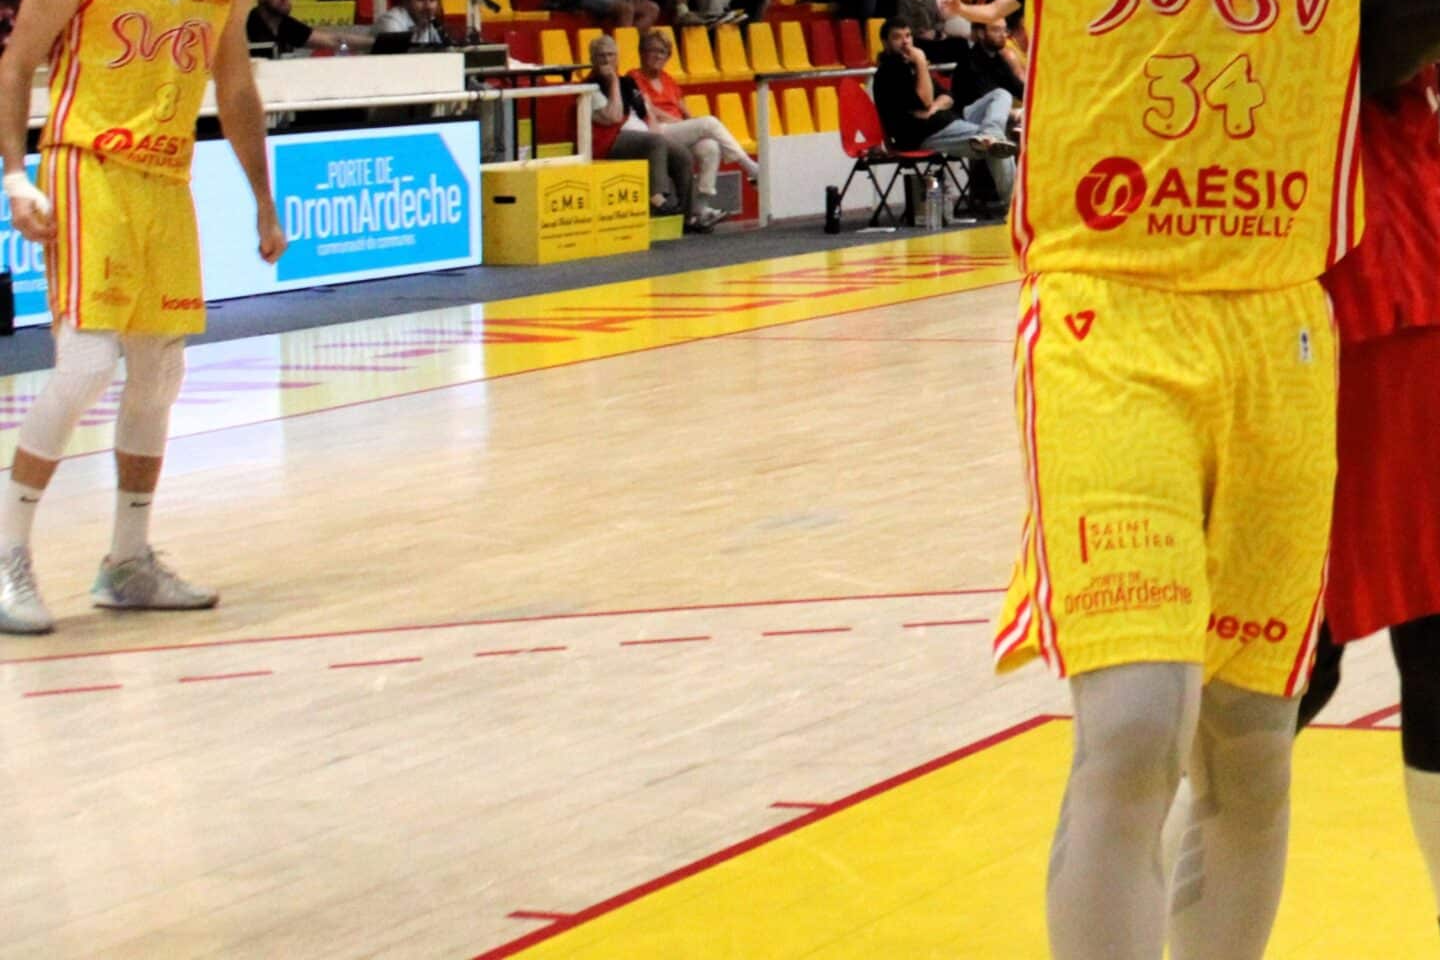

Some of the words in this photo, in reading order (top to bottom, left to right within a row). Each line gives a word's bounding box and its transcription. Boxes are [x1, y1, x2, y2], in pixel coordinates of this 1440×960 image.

[1143, 53, 1266, 139] 34
[328, 158, 373, 188] PORTE
[375, 156, 394, 183] DE
[1151, 166, 1309, 210] AÉSIO
[1091, 520, 1151, 536] SAINT
[1093, 534, 1174, 550] VALLIER
